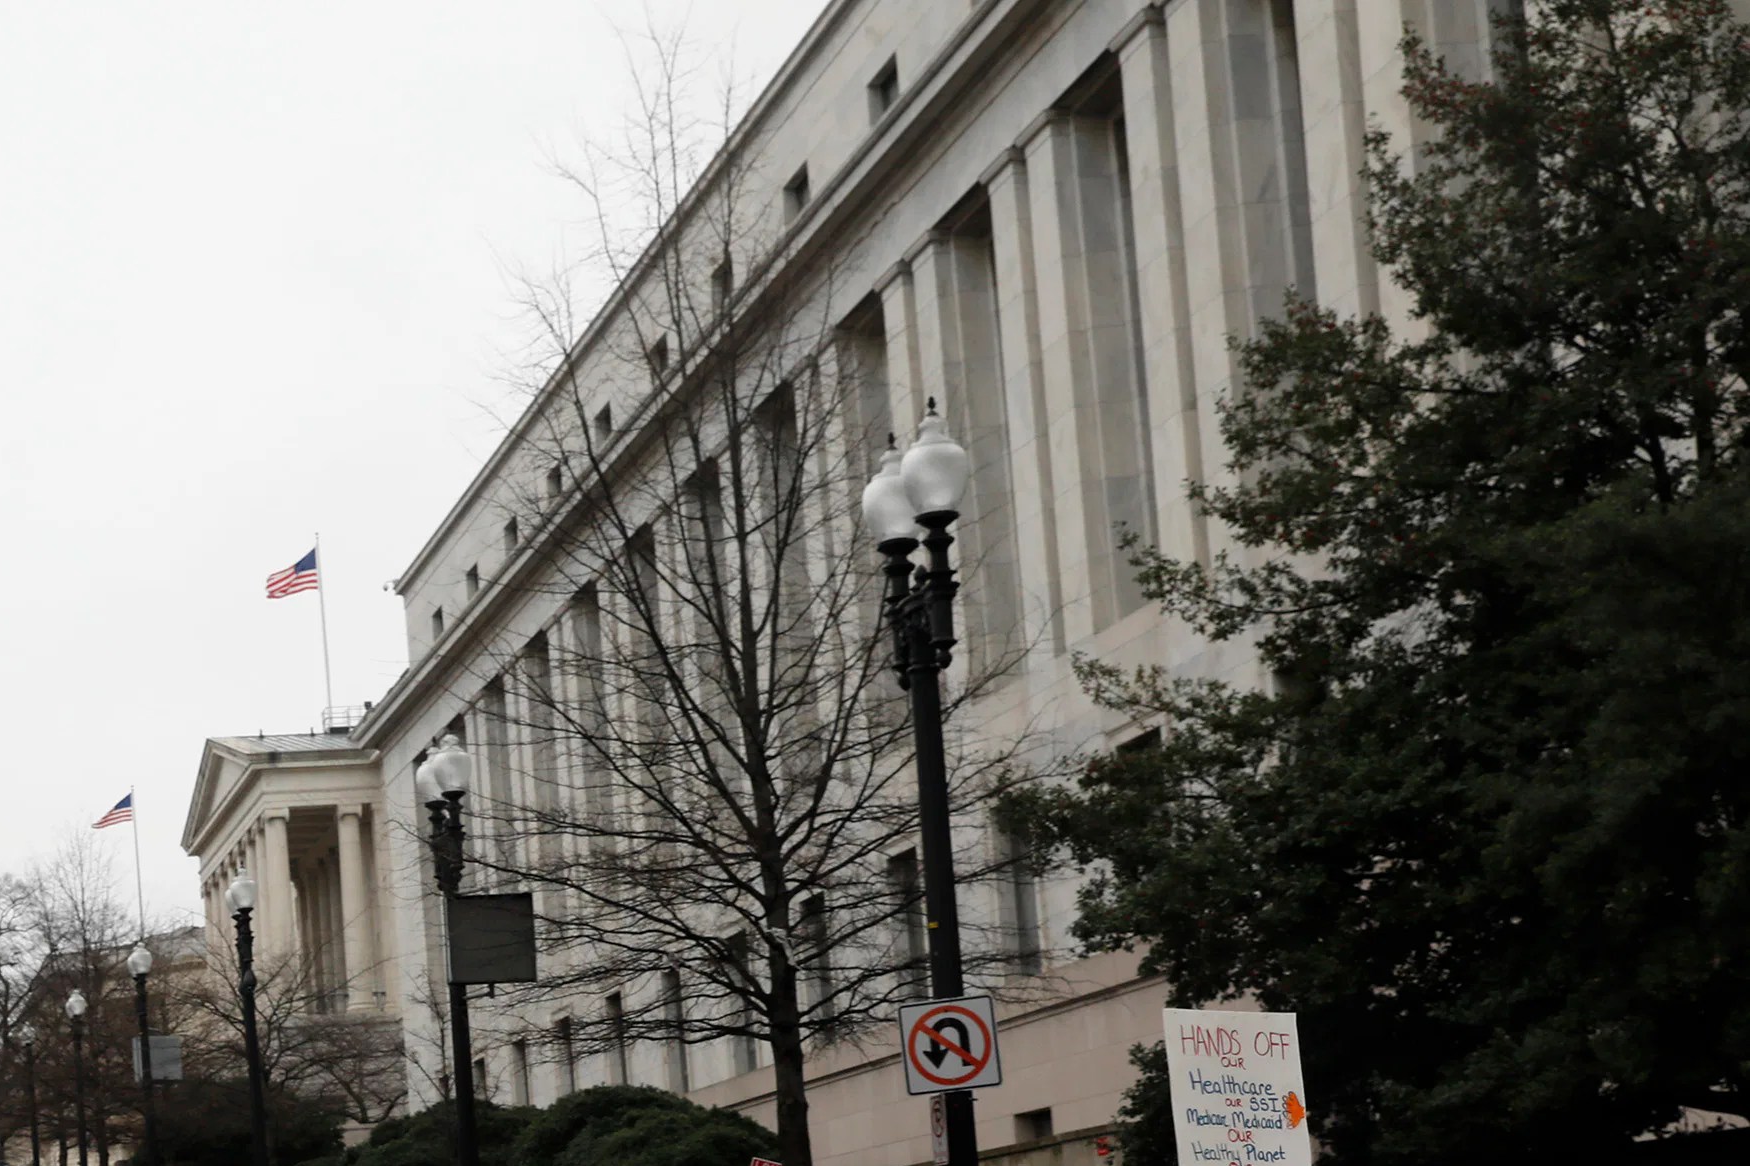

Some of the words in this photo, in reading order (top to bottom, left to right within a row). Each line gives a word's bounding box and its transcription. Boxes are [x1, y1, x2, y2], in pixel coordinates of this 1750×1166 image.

[1180, 1024, 1242, 1057] HANDS
[1254, 1031, 1290, 1060] OFF
[1221, 1057, 1246, 1070] OUR
[1189, 1068, 1276, 1096] Healthcare
[1225, 1099, 1243, 1107] OUR
[1249, 1098, 1282, 1112] SSI
[1232, 1111, 1282, 1129] Medicaid
[1227, 1129, 1255, 1144] OUR
[1243, 1144, 1286, 1163] Planet
